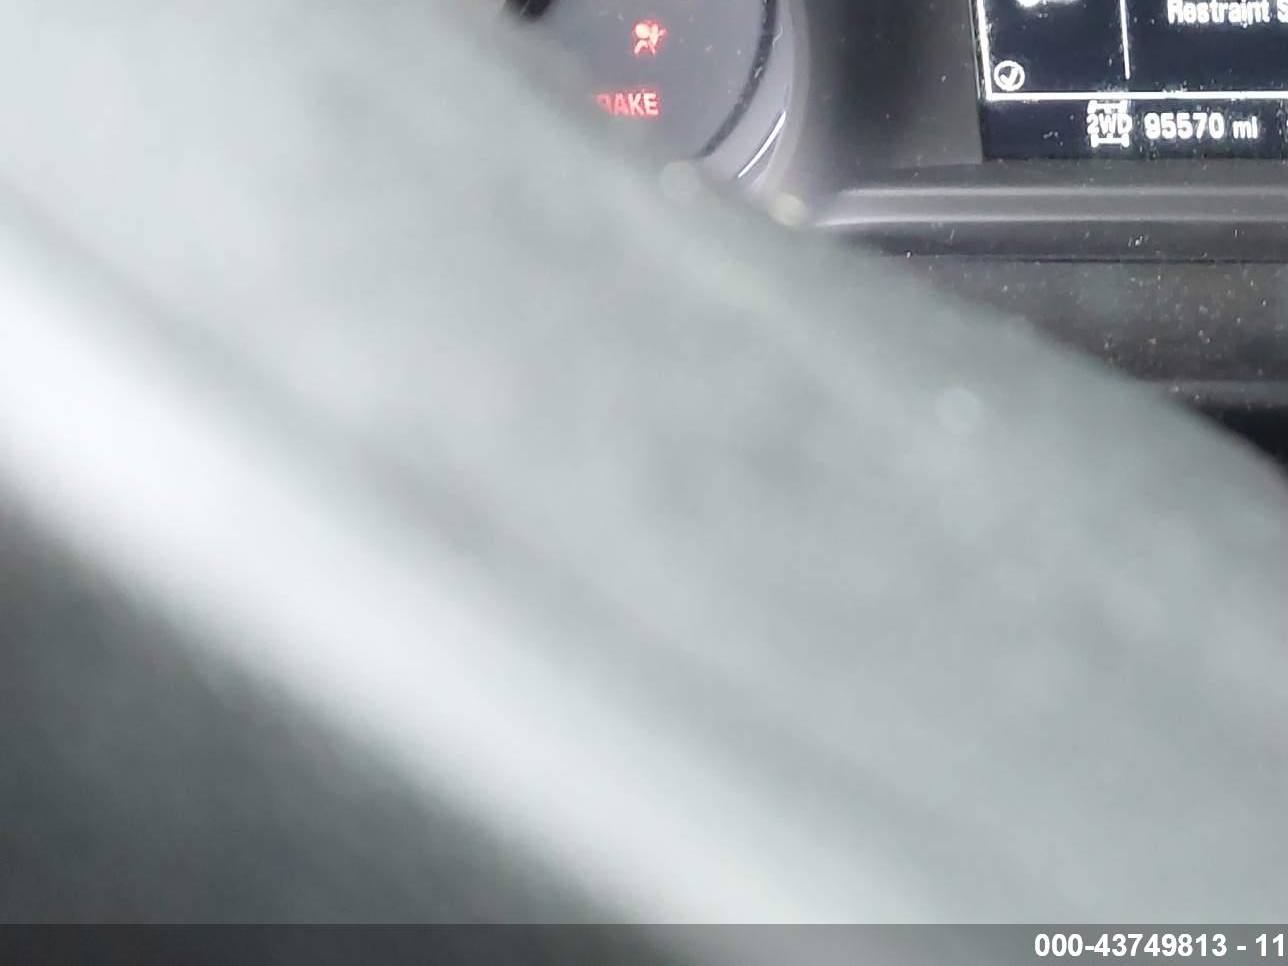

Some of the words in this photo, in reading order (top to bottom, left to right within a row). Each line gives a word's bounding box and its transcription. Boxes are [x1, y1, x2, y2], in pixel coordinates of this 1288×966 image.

[1087, 113, 1133, 135] 2WD
[1144, 112, 1225, 139] 95570
[1233, 116, 1259, 139] mi
